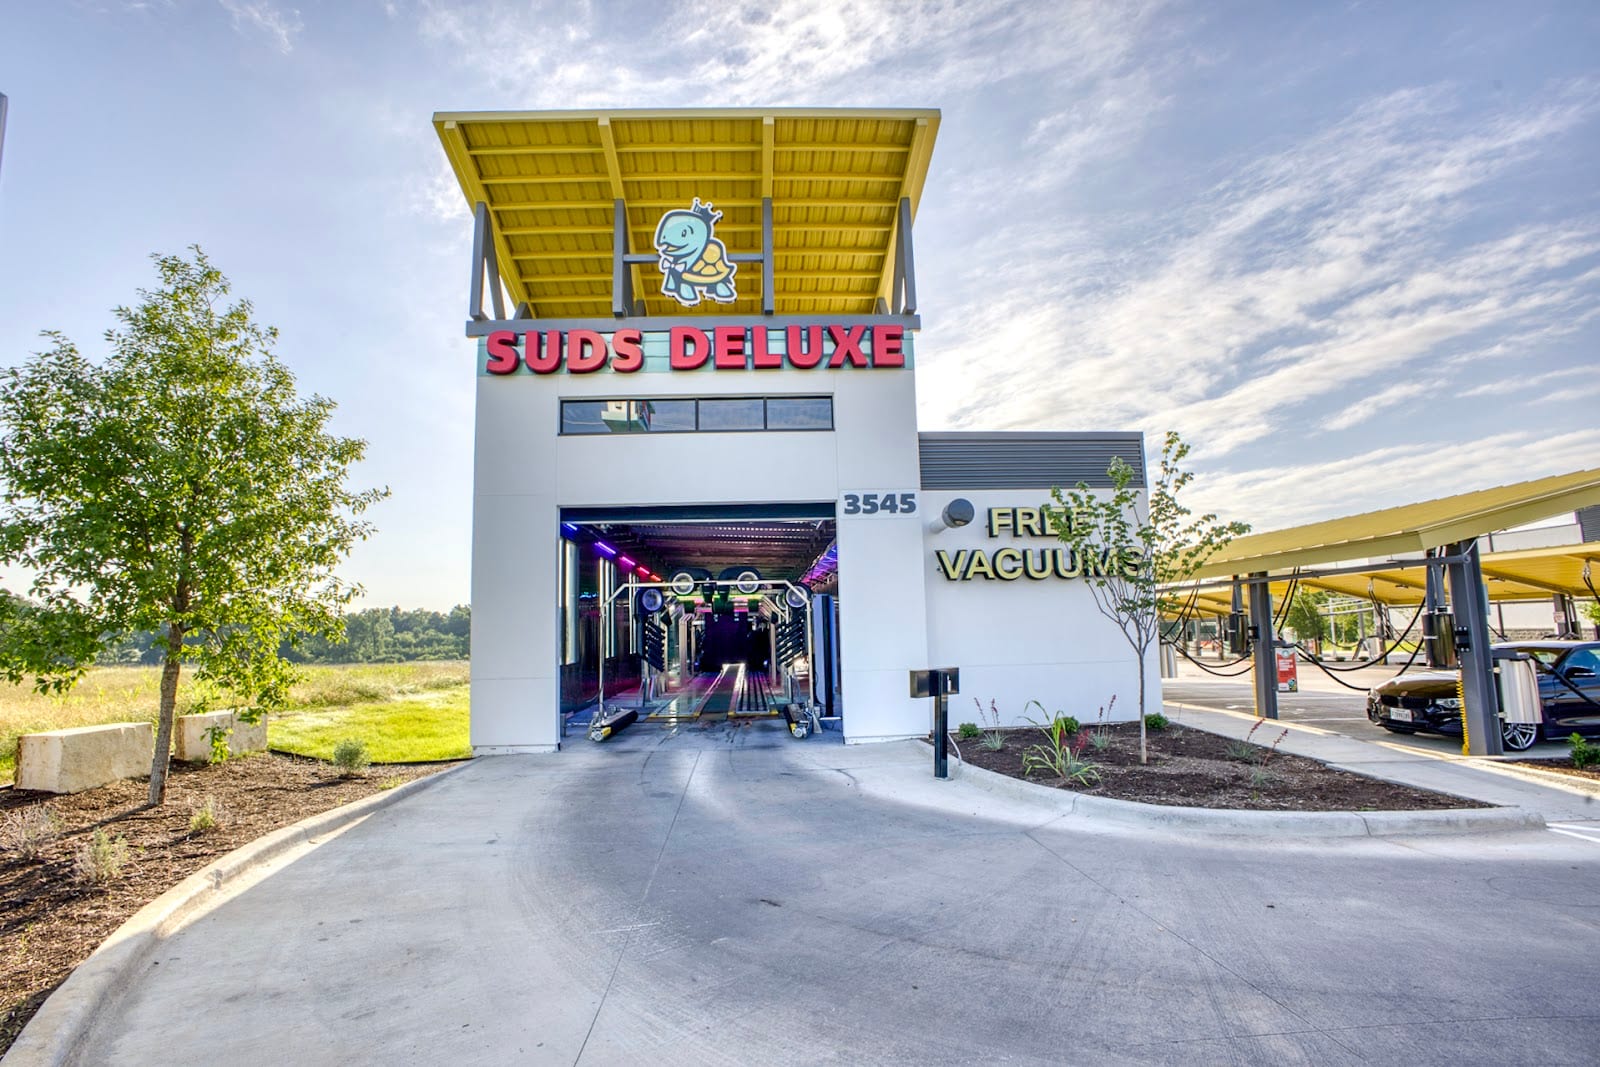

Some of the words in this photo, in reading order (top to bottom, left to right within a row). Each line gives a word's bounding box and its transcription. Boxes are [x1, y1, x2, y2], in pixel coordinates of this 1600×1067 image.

[486, 328, 643, 375] SUDS
[669, 325, 905, 371] DELUXE
[843, 493, 917, 515] 3545
